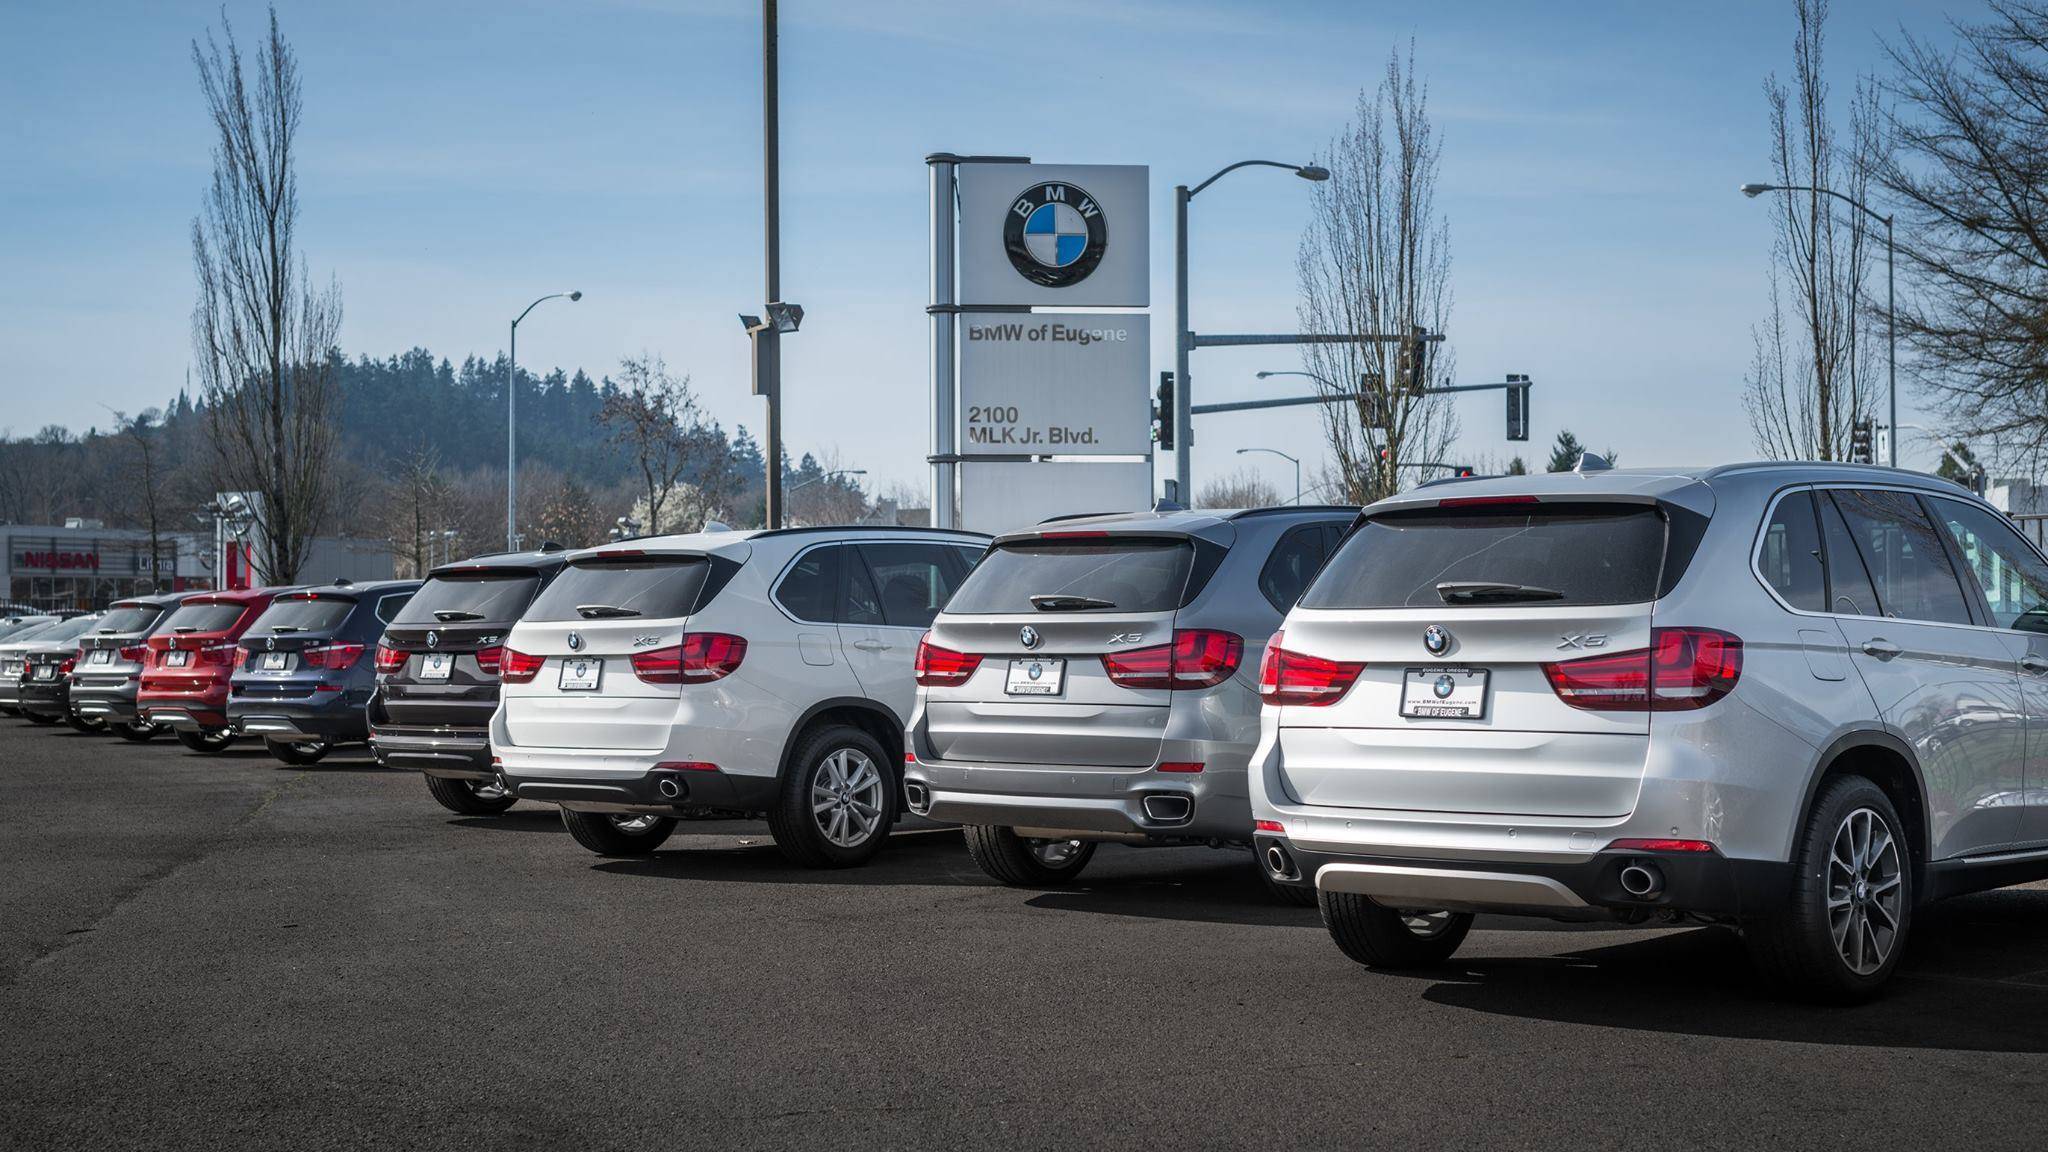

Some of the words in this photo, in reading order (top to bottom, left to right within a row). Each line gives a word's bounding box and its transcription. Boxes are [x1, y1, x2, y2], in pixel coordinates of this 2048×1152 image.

[1012, 186, 1098, 219] BMW
[969, 323, 1023, 341] BMW
[1028, 324, 1048, 341] of
[1052, 324, 1127, 345] Eugene
[969, 406, 1018, 423] 2100
[969, 427, 1016, 443] MLK
[1020, 427, 1043, 444] Jr.
[1049, 427, 1099, 444] Blvd.
[24, 551, 99, 569] NISSAN
[1107, 633, 1143, 645] X5
[1556, 634, 1607, 650] X5
